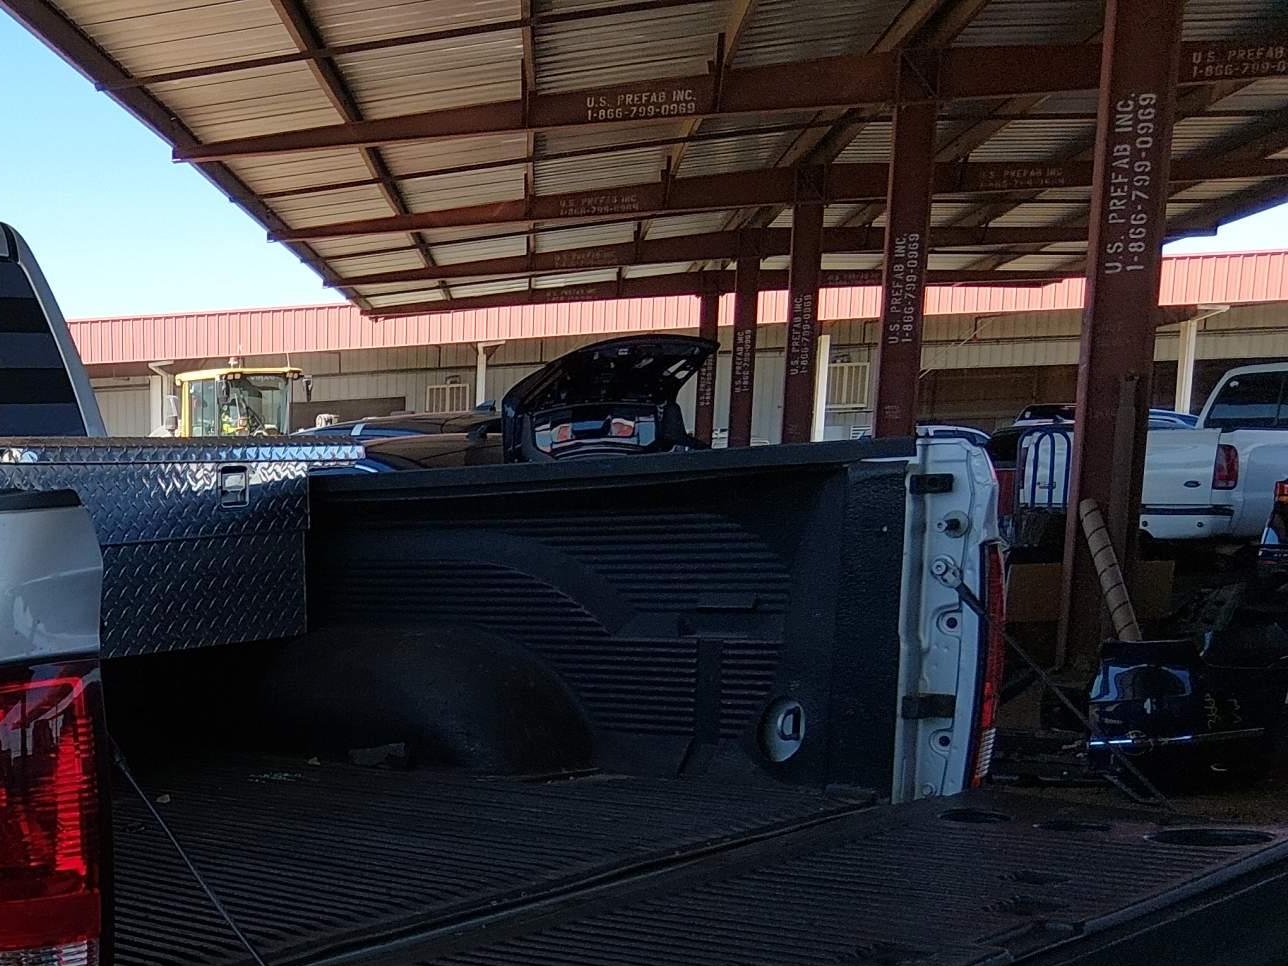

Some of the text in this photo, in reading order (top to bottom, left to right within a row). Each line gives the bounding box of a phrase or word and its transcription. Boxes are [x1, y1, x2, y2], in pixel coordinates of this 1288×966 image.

[586, 89, 697, 108] U.S. PREFAB INC.
[587, 102, 696, 120] 1-866-799-0969
[1104, 93, 1136, 274] U.S. PREFAB INC.
[1125, 93, 1157, 271] 1-866-799-0969
[888, 233, 908, 344] U.S. PREFAB INC.
[901, 233, 920, 342] 1-866-799-0969
